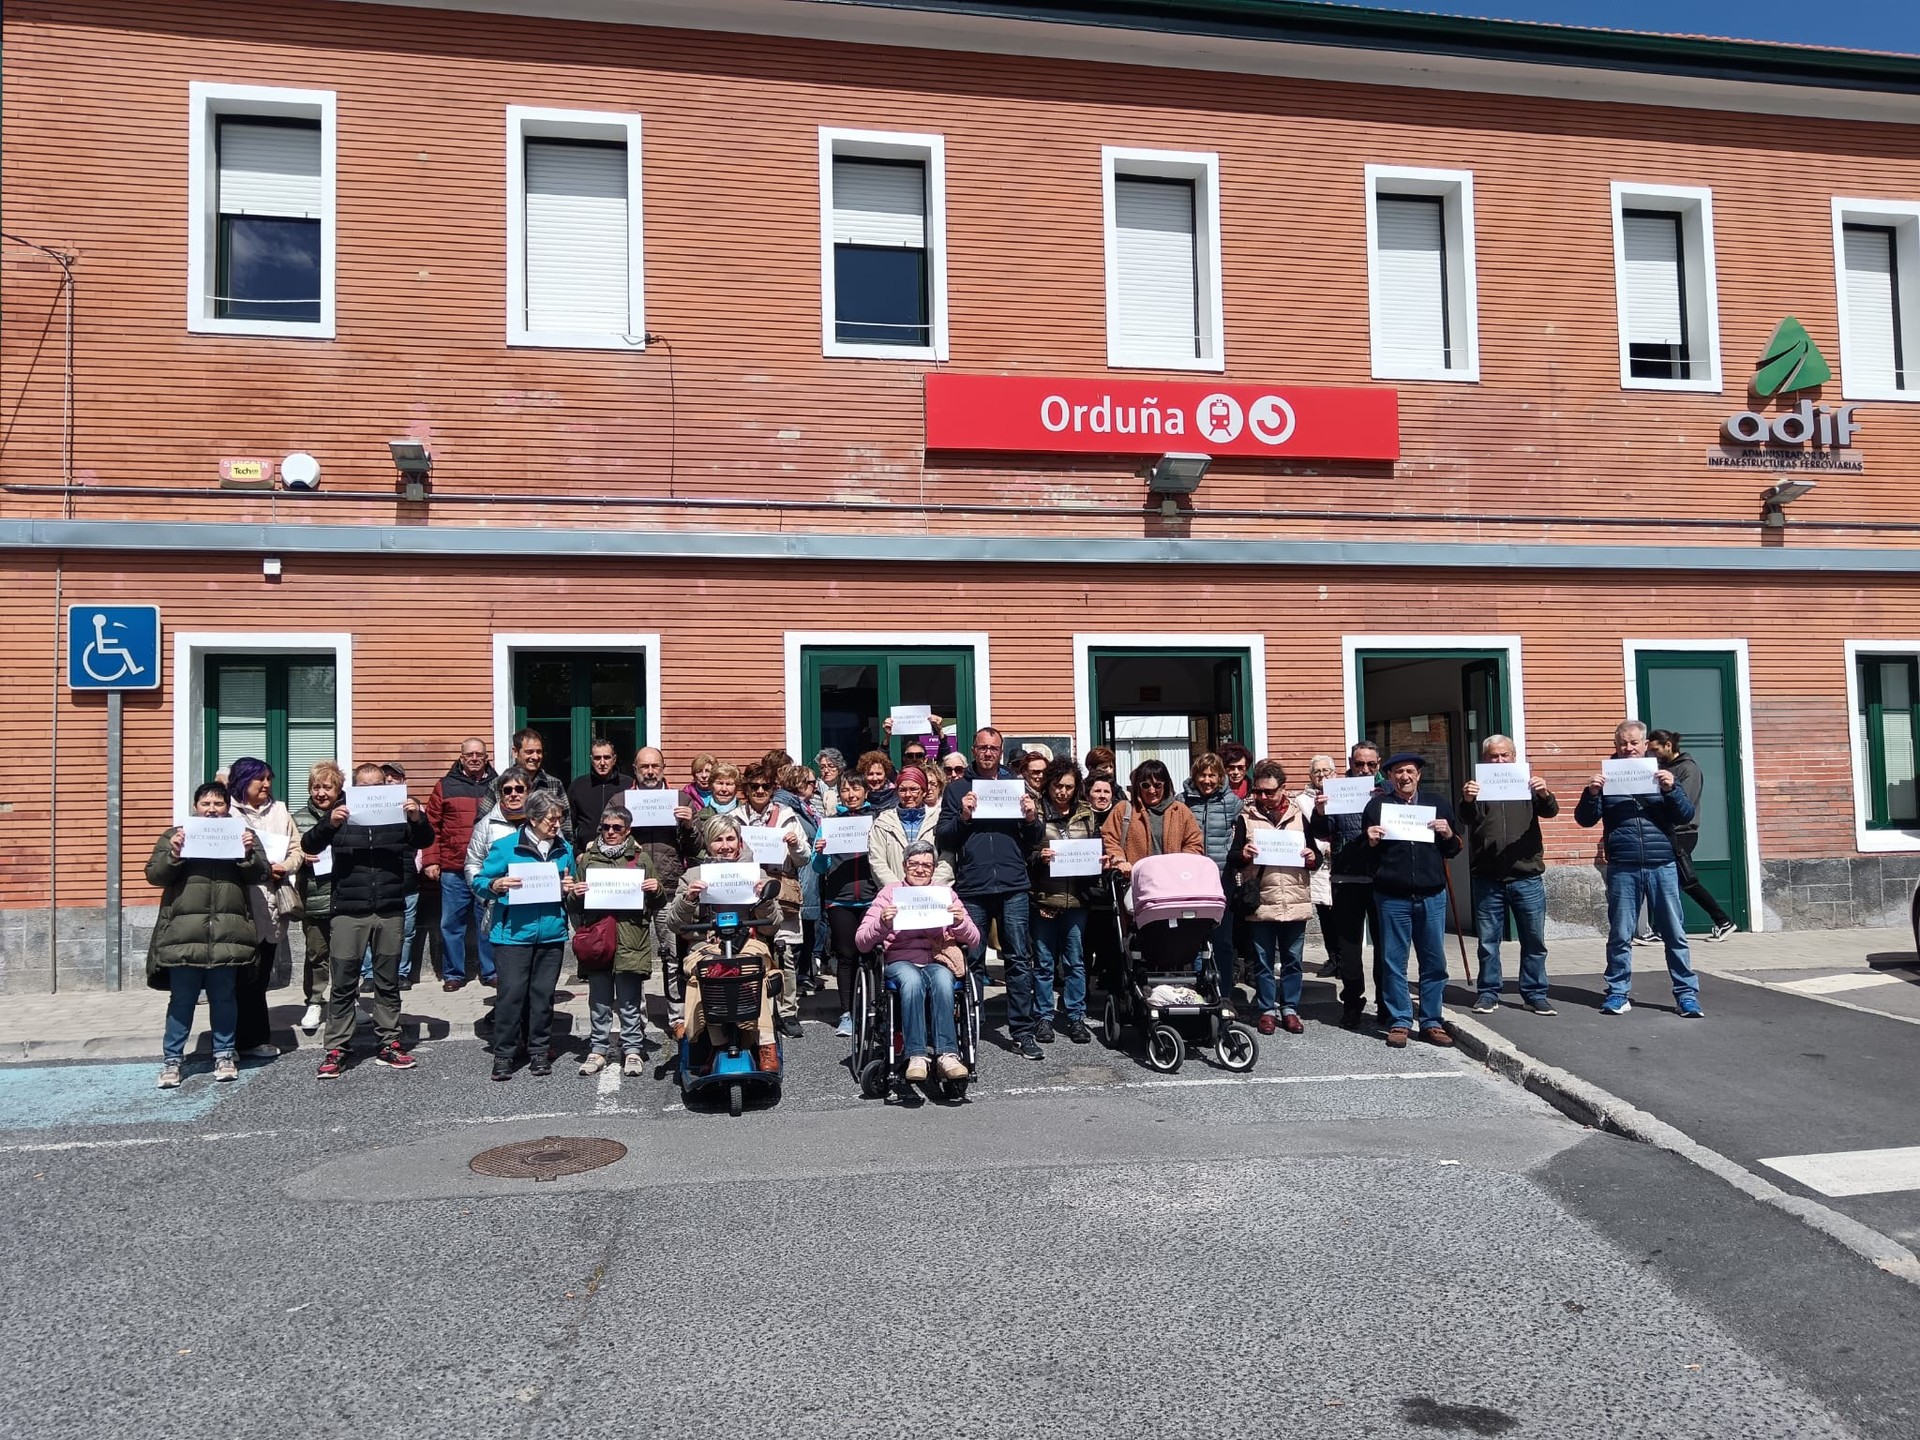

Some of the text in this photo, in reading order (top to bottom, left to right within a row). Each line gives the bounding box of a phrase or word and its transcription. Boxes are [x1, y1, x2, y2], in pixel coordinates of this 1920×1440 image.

[1040, 395, 1185, 435] Orduña
[1728, 399, 1865, 445] adif
[1708, 457, 1863, 472] INFRAESTRUCTURAS FERROVIARIAS
[1742, 449, 1831, 461] ADMINISTRADOR DE
